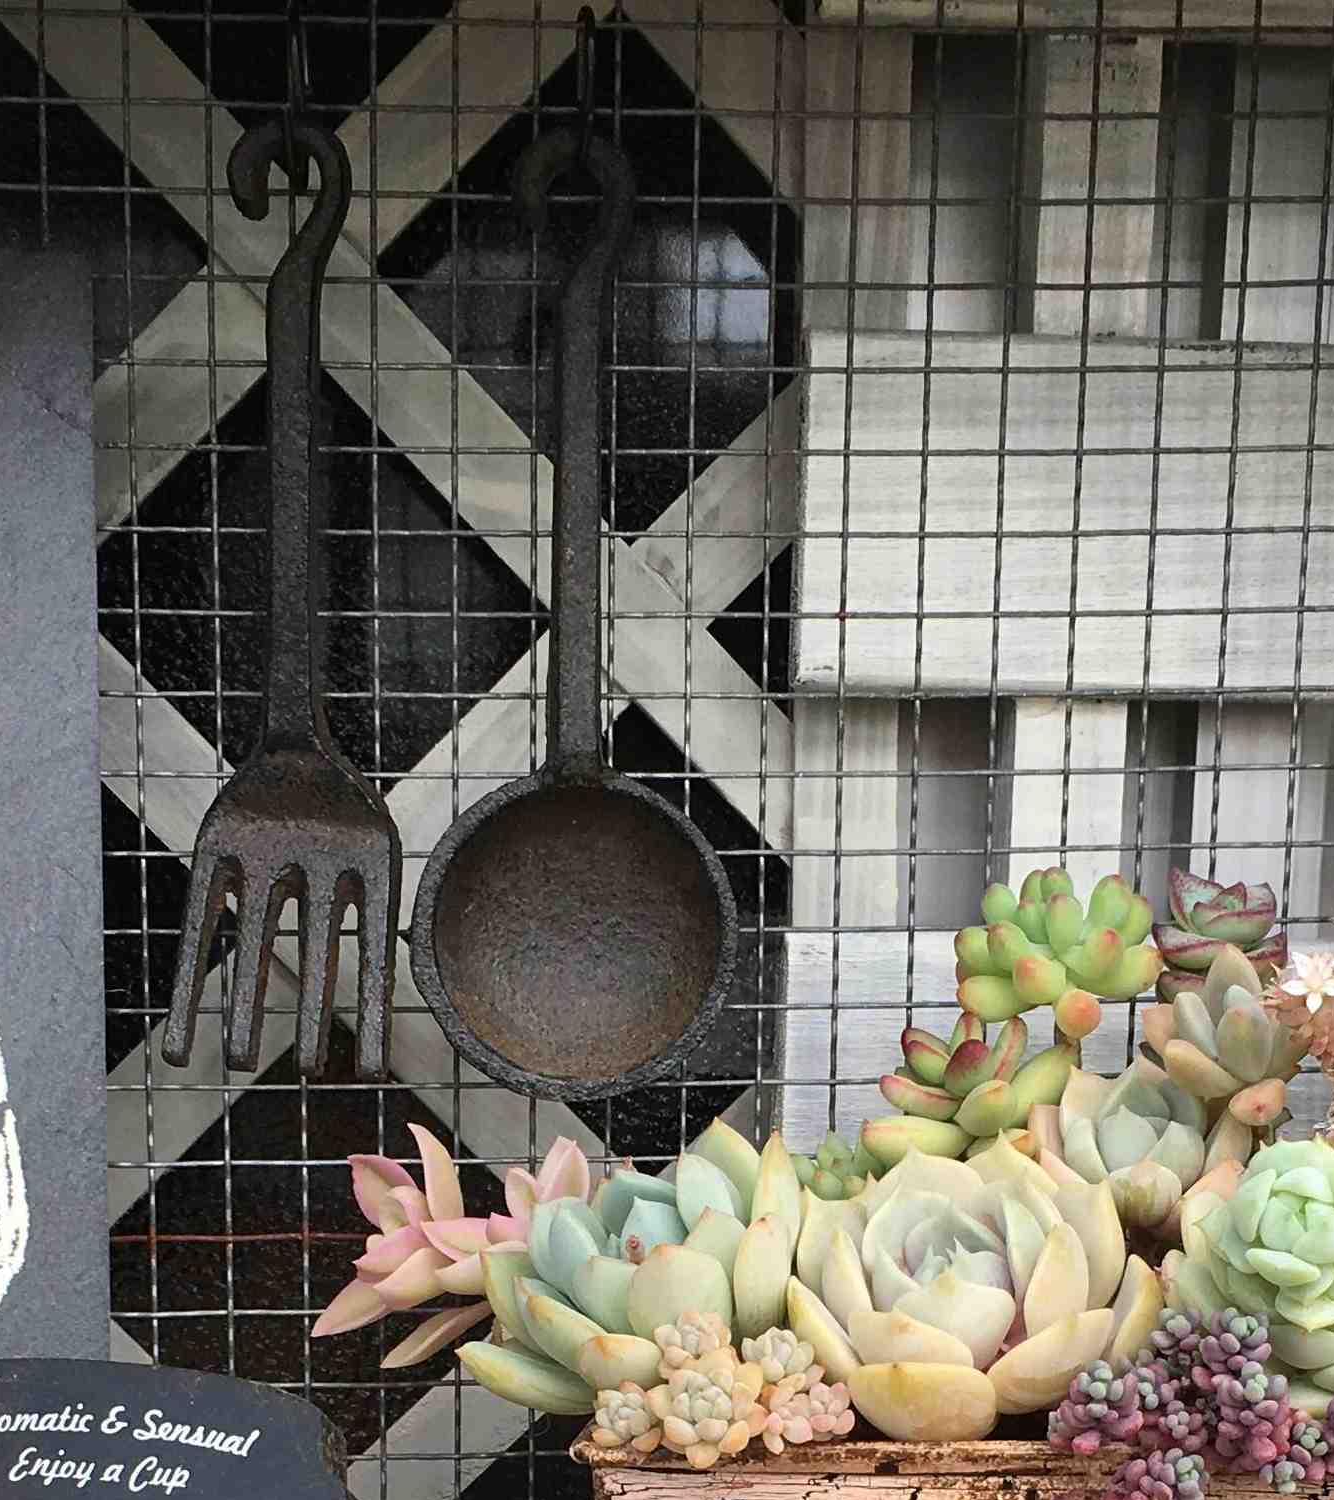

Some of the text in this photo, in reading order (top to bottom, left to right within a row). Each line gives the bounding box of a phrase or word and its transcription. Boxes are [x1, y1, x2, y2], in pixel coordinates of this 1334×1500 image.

[101, 1405, 128, 1434] &
[133, 1408, 261, 1457] Sensual
[8, 1447, 192, 1495] Enjoy a Cup
